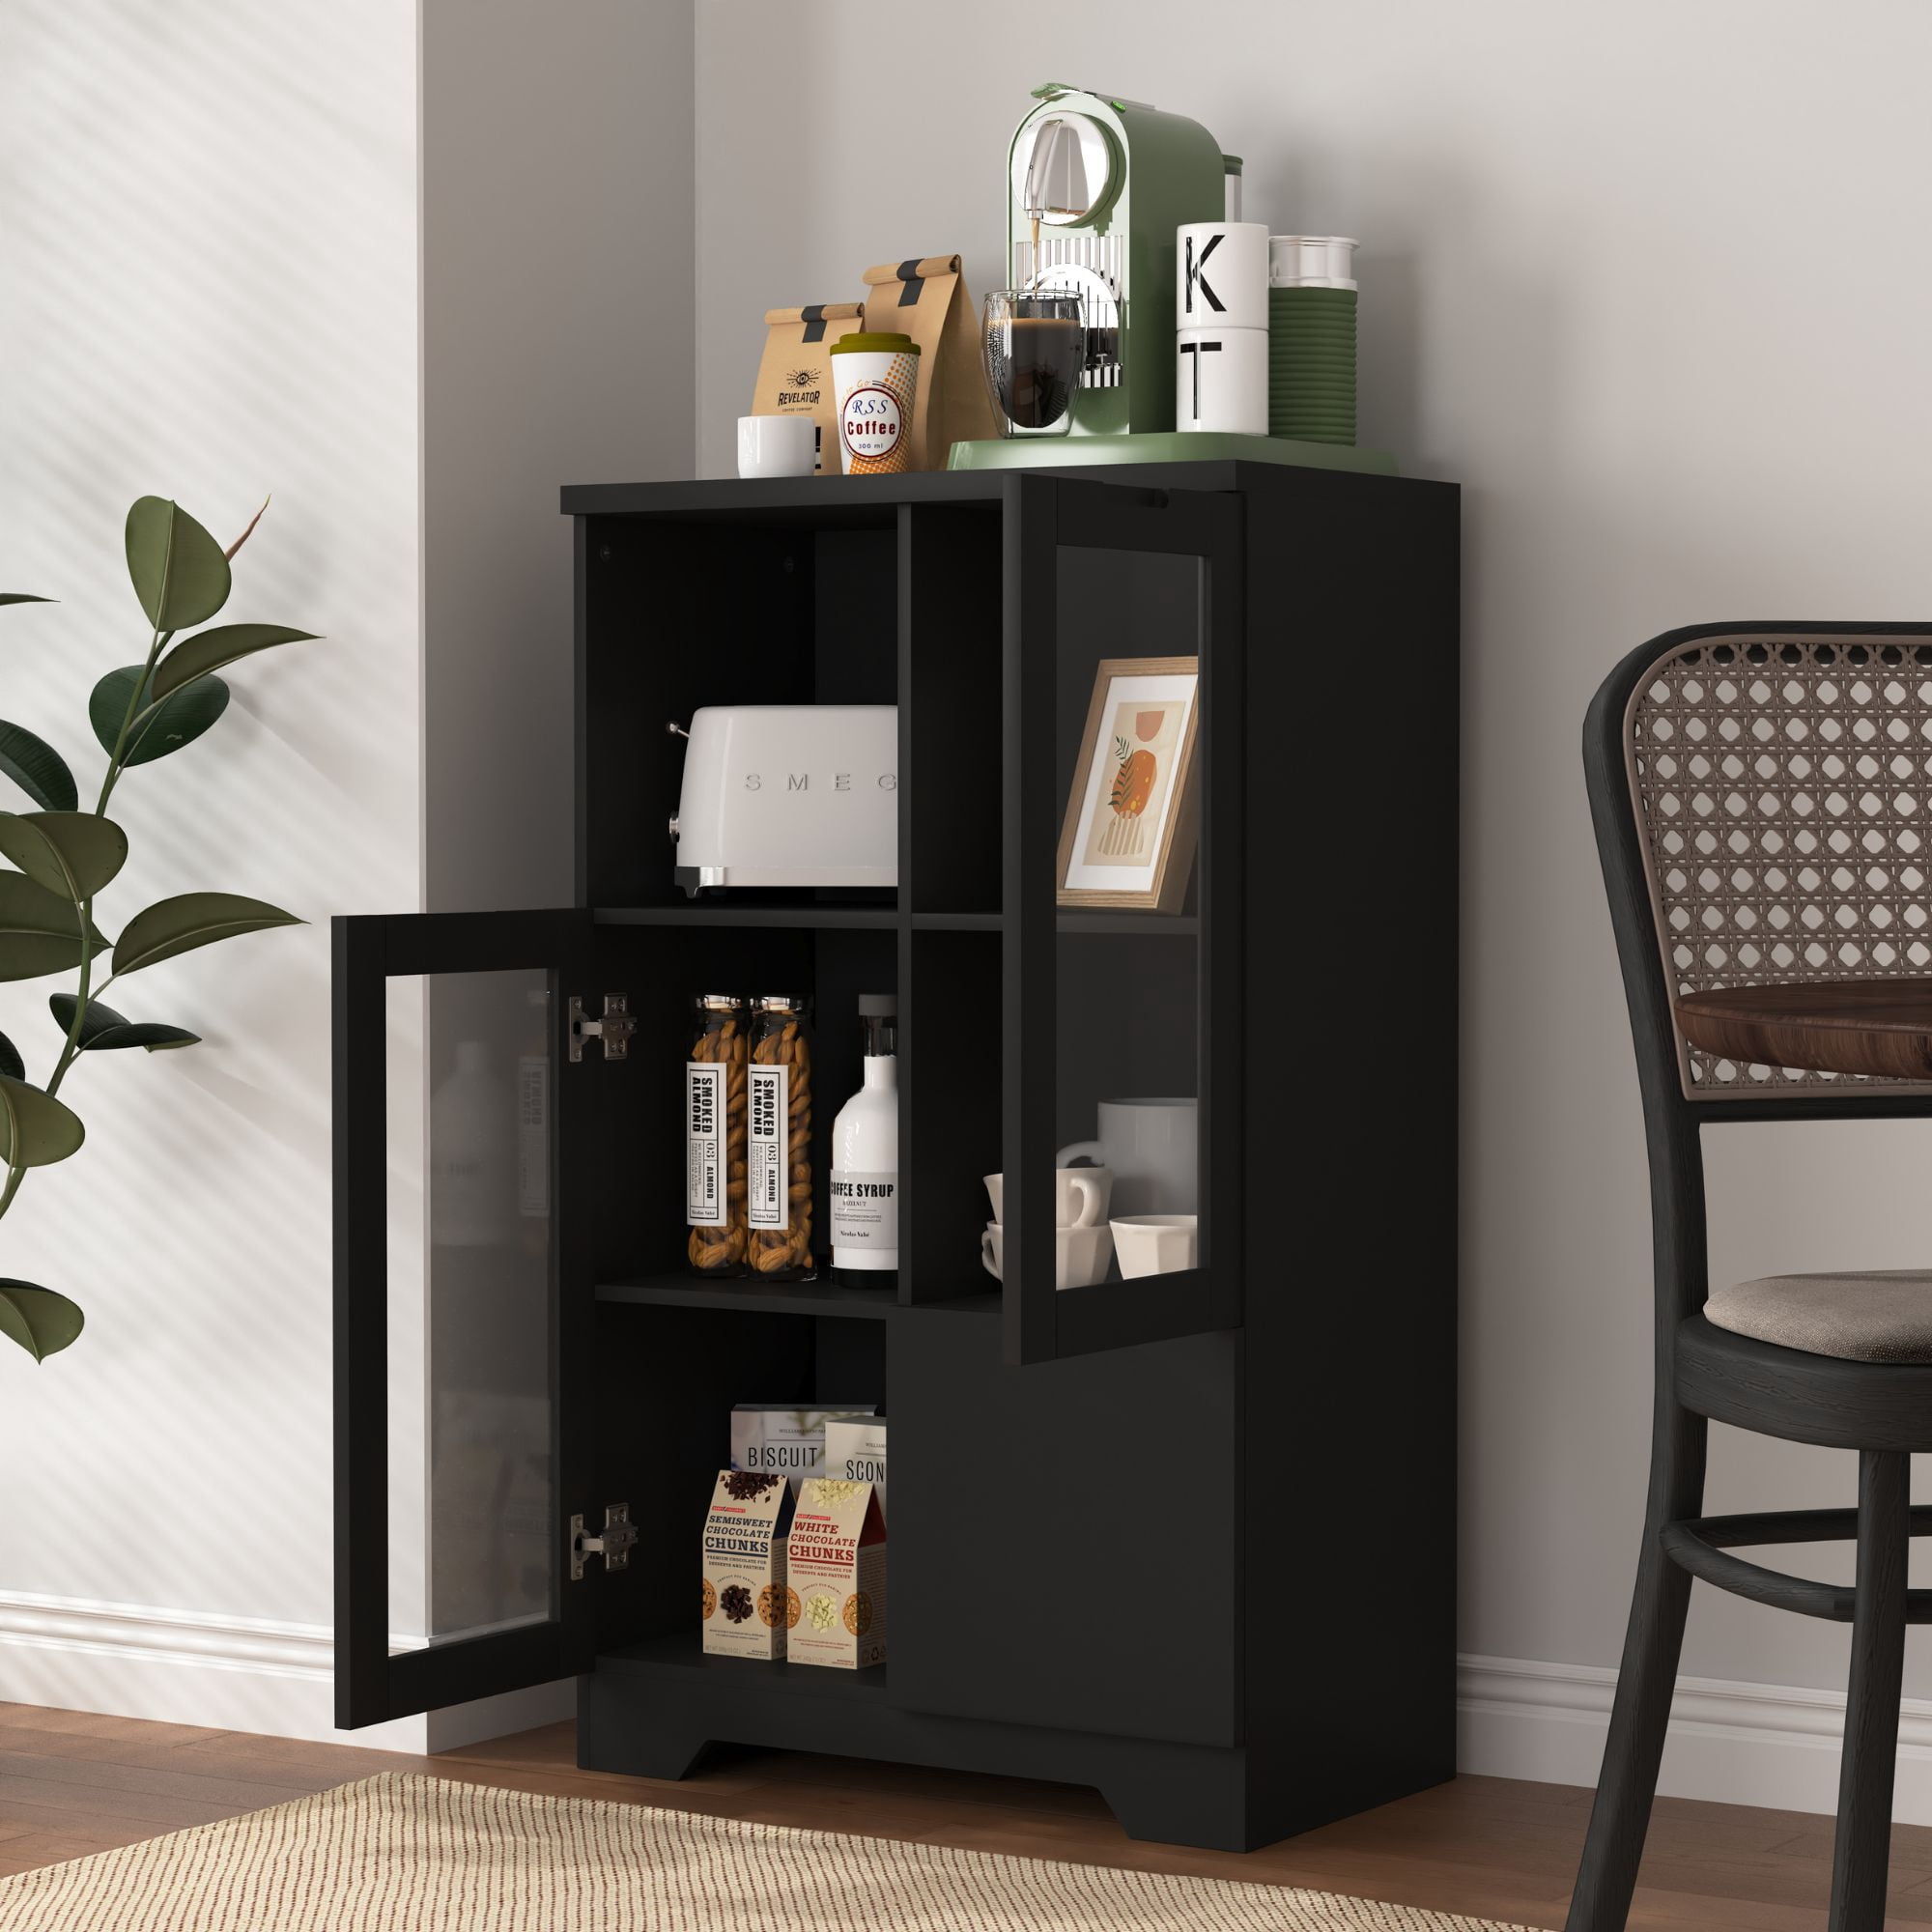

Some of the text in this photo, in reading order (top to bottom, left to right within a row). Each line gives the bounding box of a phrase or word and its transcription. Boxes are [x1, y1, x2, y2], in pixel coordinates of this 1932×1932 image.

[1186, 234, 1227, 313] K
[1180, 341, 1222, 420] T
[778, 390, 821, 406] REVELATOR
[847, 420, 896, 435] Coffee
[745, 774, 897, 791] SMEG
[692, 1077, 701, 1132] ALMOND
[702, 1077, 713, 1133] SMOKED
[753, 1079, 762, 1135] ALMOND
[763, 1079, 774, 1136] SMOKED
[706, 1142, 715, 1158] 03
[767, 1145, 776, 1161] 03
[856, 1183, 894, 1198] SYRUP
[748, 1447, 818, 1467] BISCUIT
[709, 1515, 773, 1528] SEMISWEET
[794, 1521, 839, 1534] WHITE
[706, 1526, 770, 1539] CHOCOLATE
[791, 1533, 856, 1547] CHOCOLATE
[705, 1536, 769, 1553] CHUNKS
[790, 1545, 854, 1561] CHUNKS
